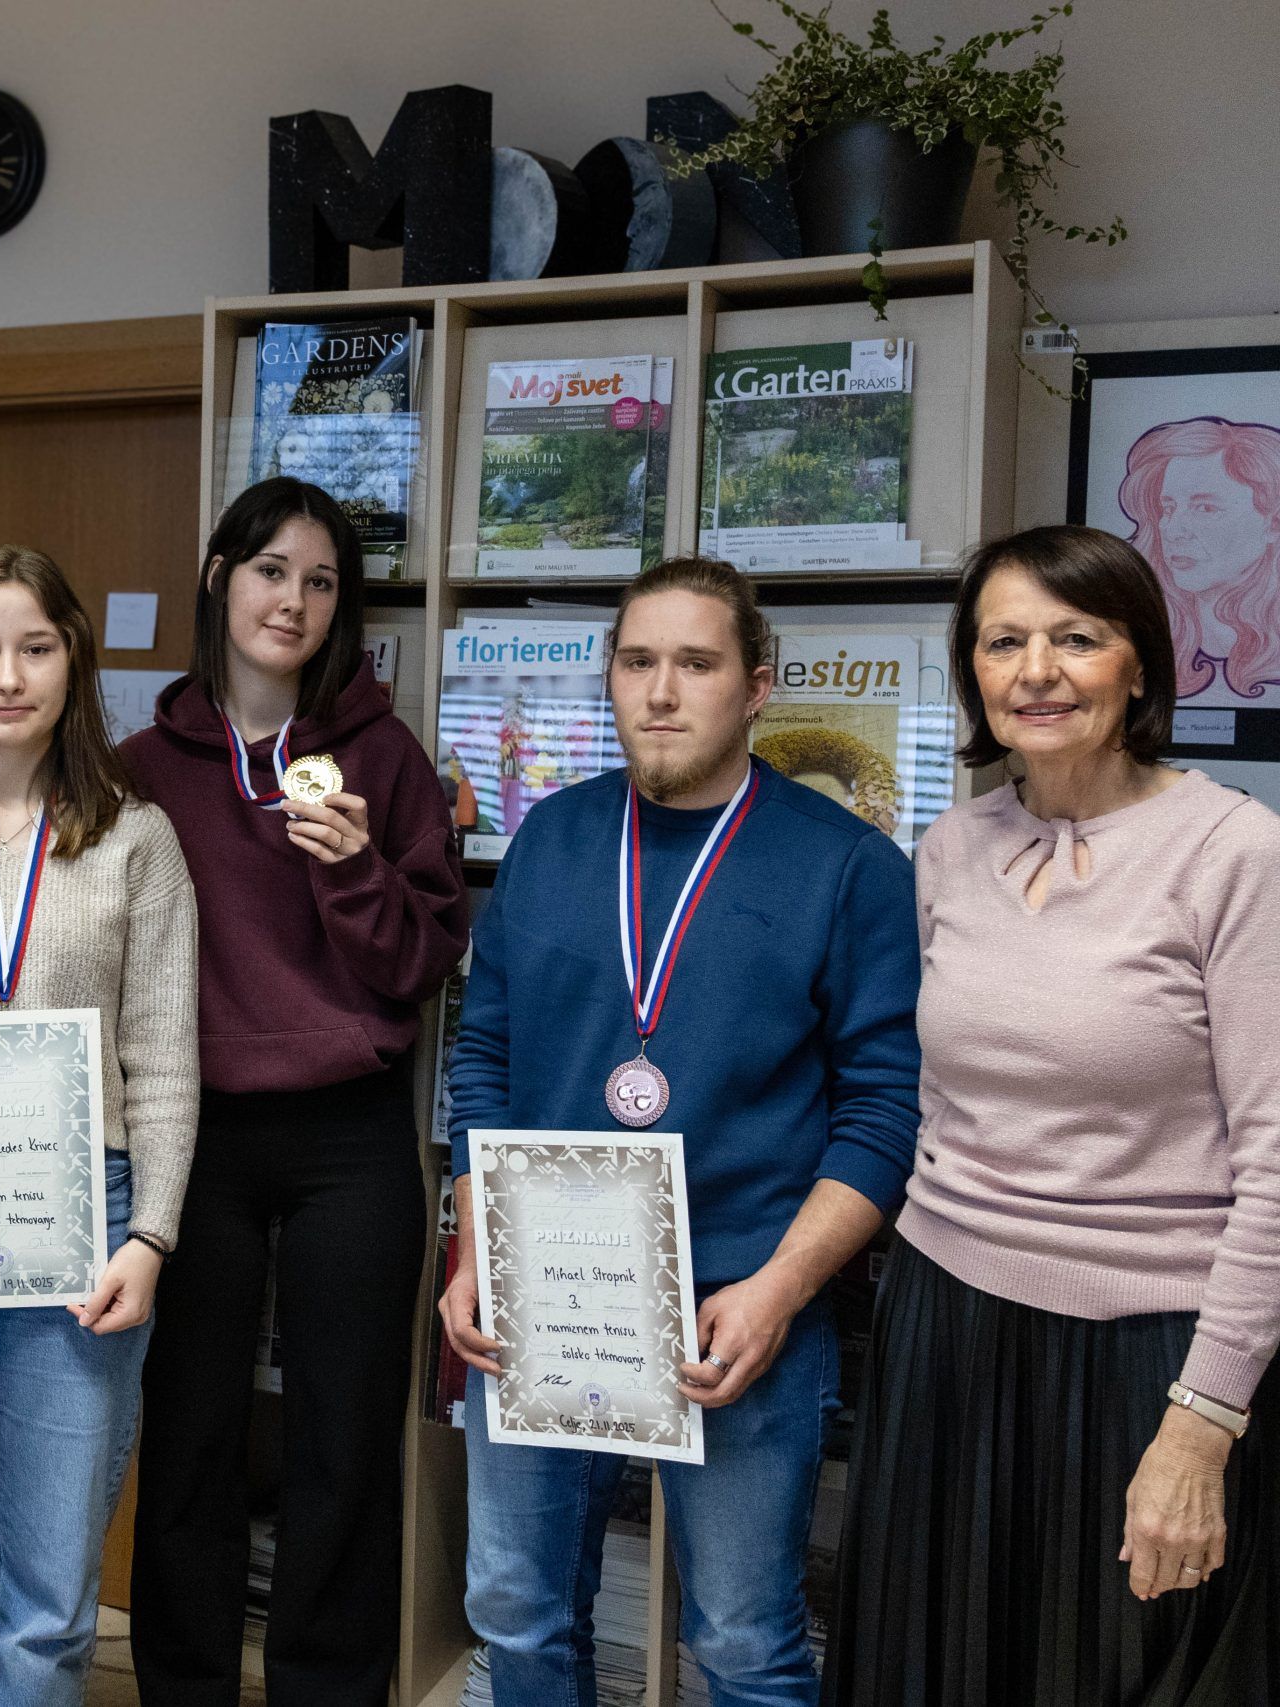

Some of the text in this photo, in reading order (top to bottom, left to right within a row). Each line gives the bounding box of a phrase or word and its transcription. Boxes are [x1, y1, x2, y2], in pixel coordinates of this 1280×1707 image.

[262, 333, 404, 365] GARDENS
[293, 363, 371, 376] ILLUSTRATED
[509, 374, 565, 406] Moj
[566, 373, 623, 397] svet
[732, 364, 897, 398] Garten PRAXIS
[829, 557, 850, 565] PRAXIS
[456, 635, 594, 663] florieren!
[28, 1137, 60, 1152] Krivec
[12, 1189, 45, 1202] tenisu
[6, 1211, 57, 1230] tekmovanje
[535, 1230, 631, 1247] PRIZNANJE
[544, 1266, 637, 1287] Mihael Stropnik
[568, 1294, 581, 1309] 3.
[534, 1322, 637, 1337] v namiznem tenisu
[561, 1344, 646, 1372] šolsko tekmovanje
[559, 1414, 586, 1433] Celje,
